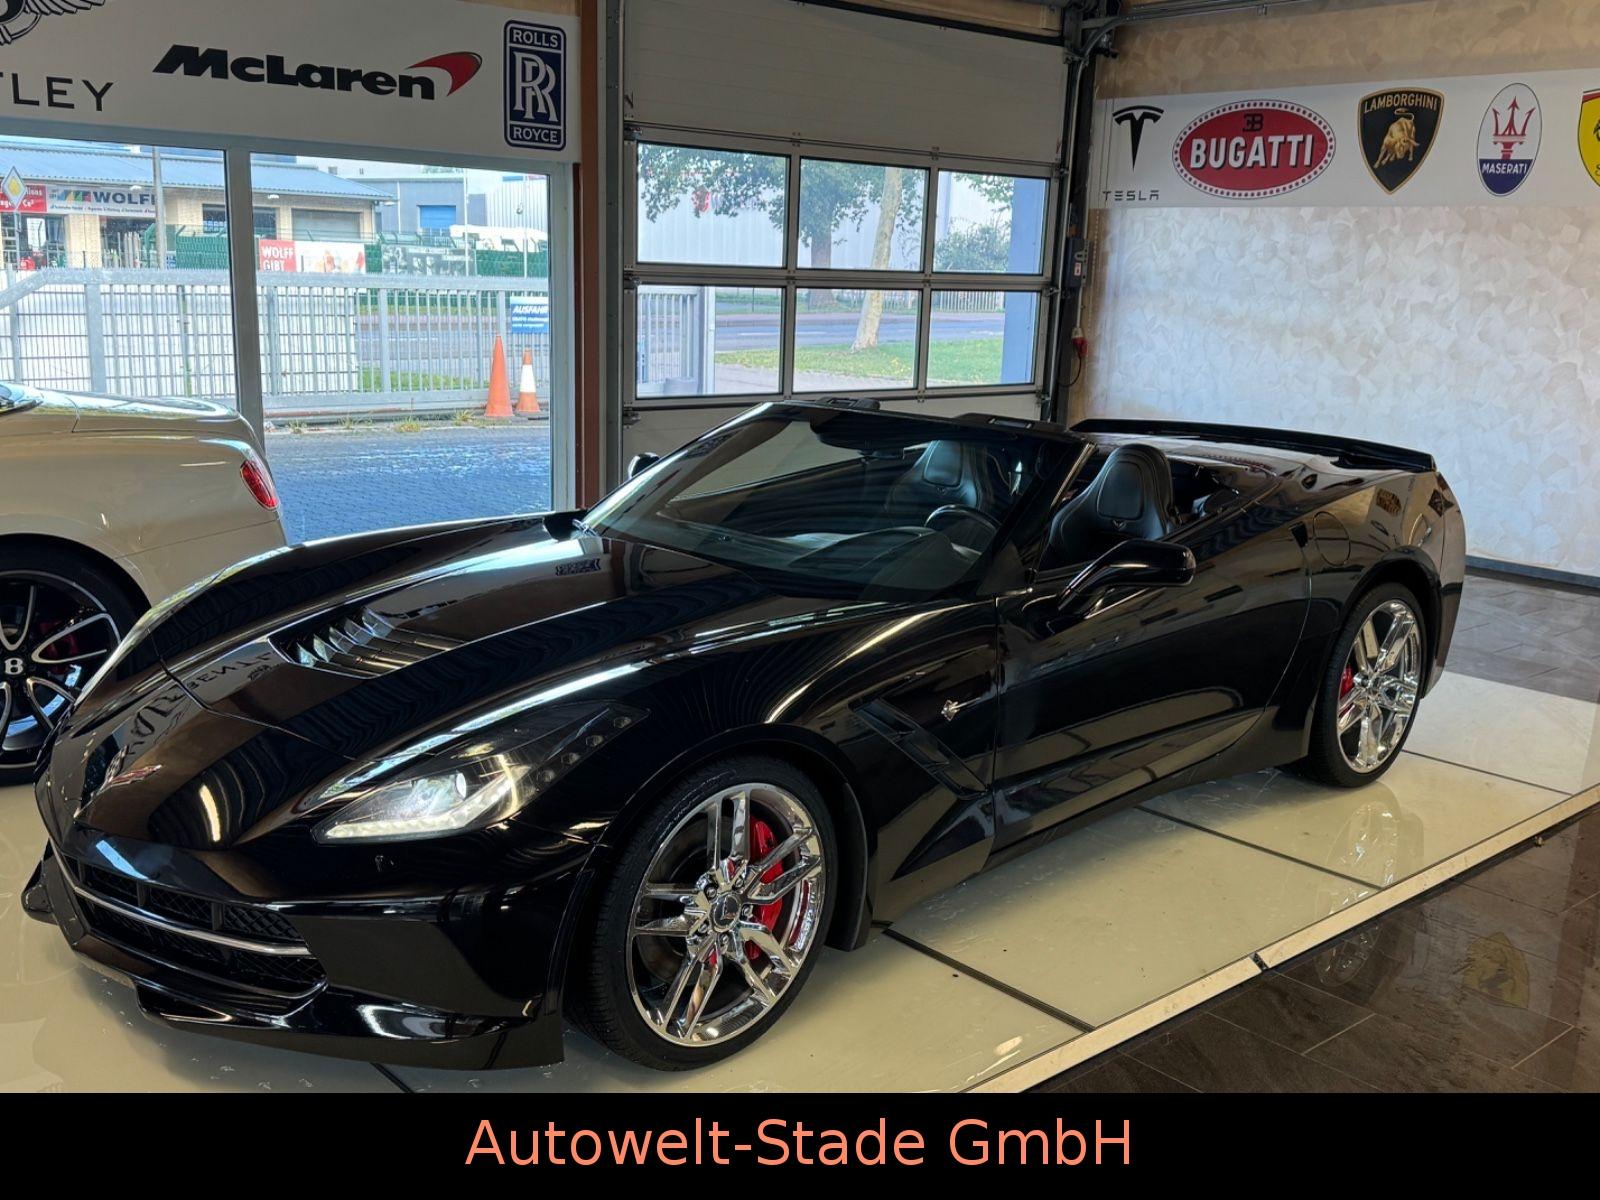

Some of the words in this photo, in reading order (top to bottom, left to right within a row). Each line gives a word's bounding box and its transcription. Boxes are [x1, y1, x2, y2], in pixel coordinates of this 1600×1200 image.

[512, 29, 558, 48] ROLLS
[152, 44, 435, 101] McLaren
[0, 71, 114, 112] LEY
[1364, 93, 1438, 113] LAMBORGHINI
[513, 126, 558, 143] ROYCE
[1190, 134, 1315, 170] BUGATTI
[1482, 162, 1528, 175] MASERATI
[1102, 189, 1160, 201] TESLA
[261, 245, 294, 259] WOLFF
[5, 657, 23, 675] B
